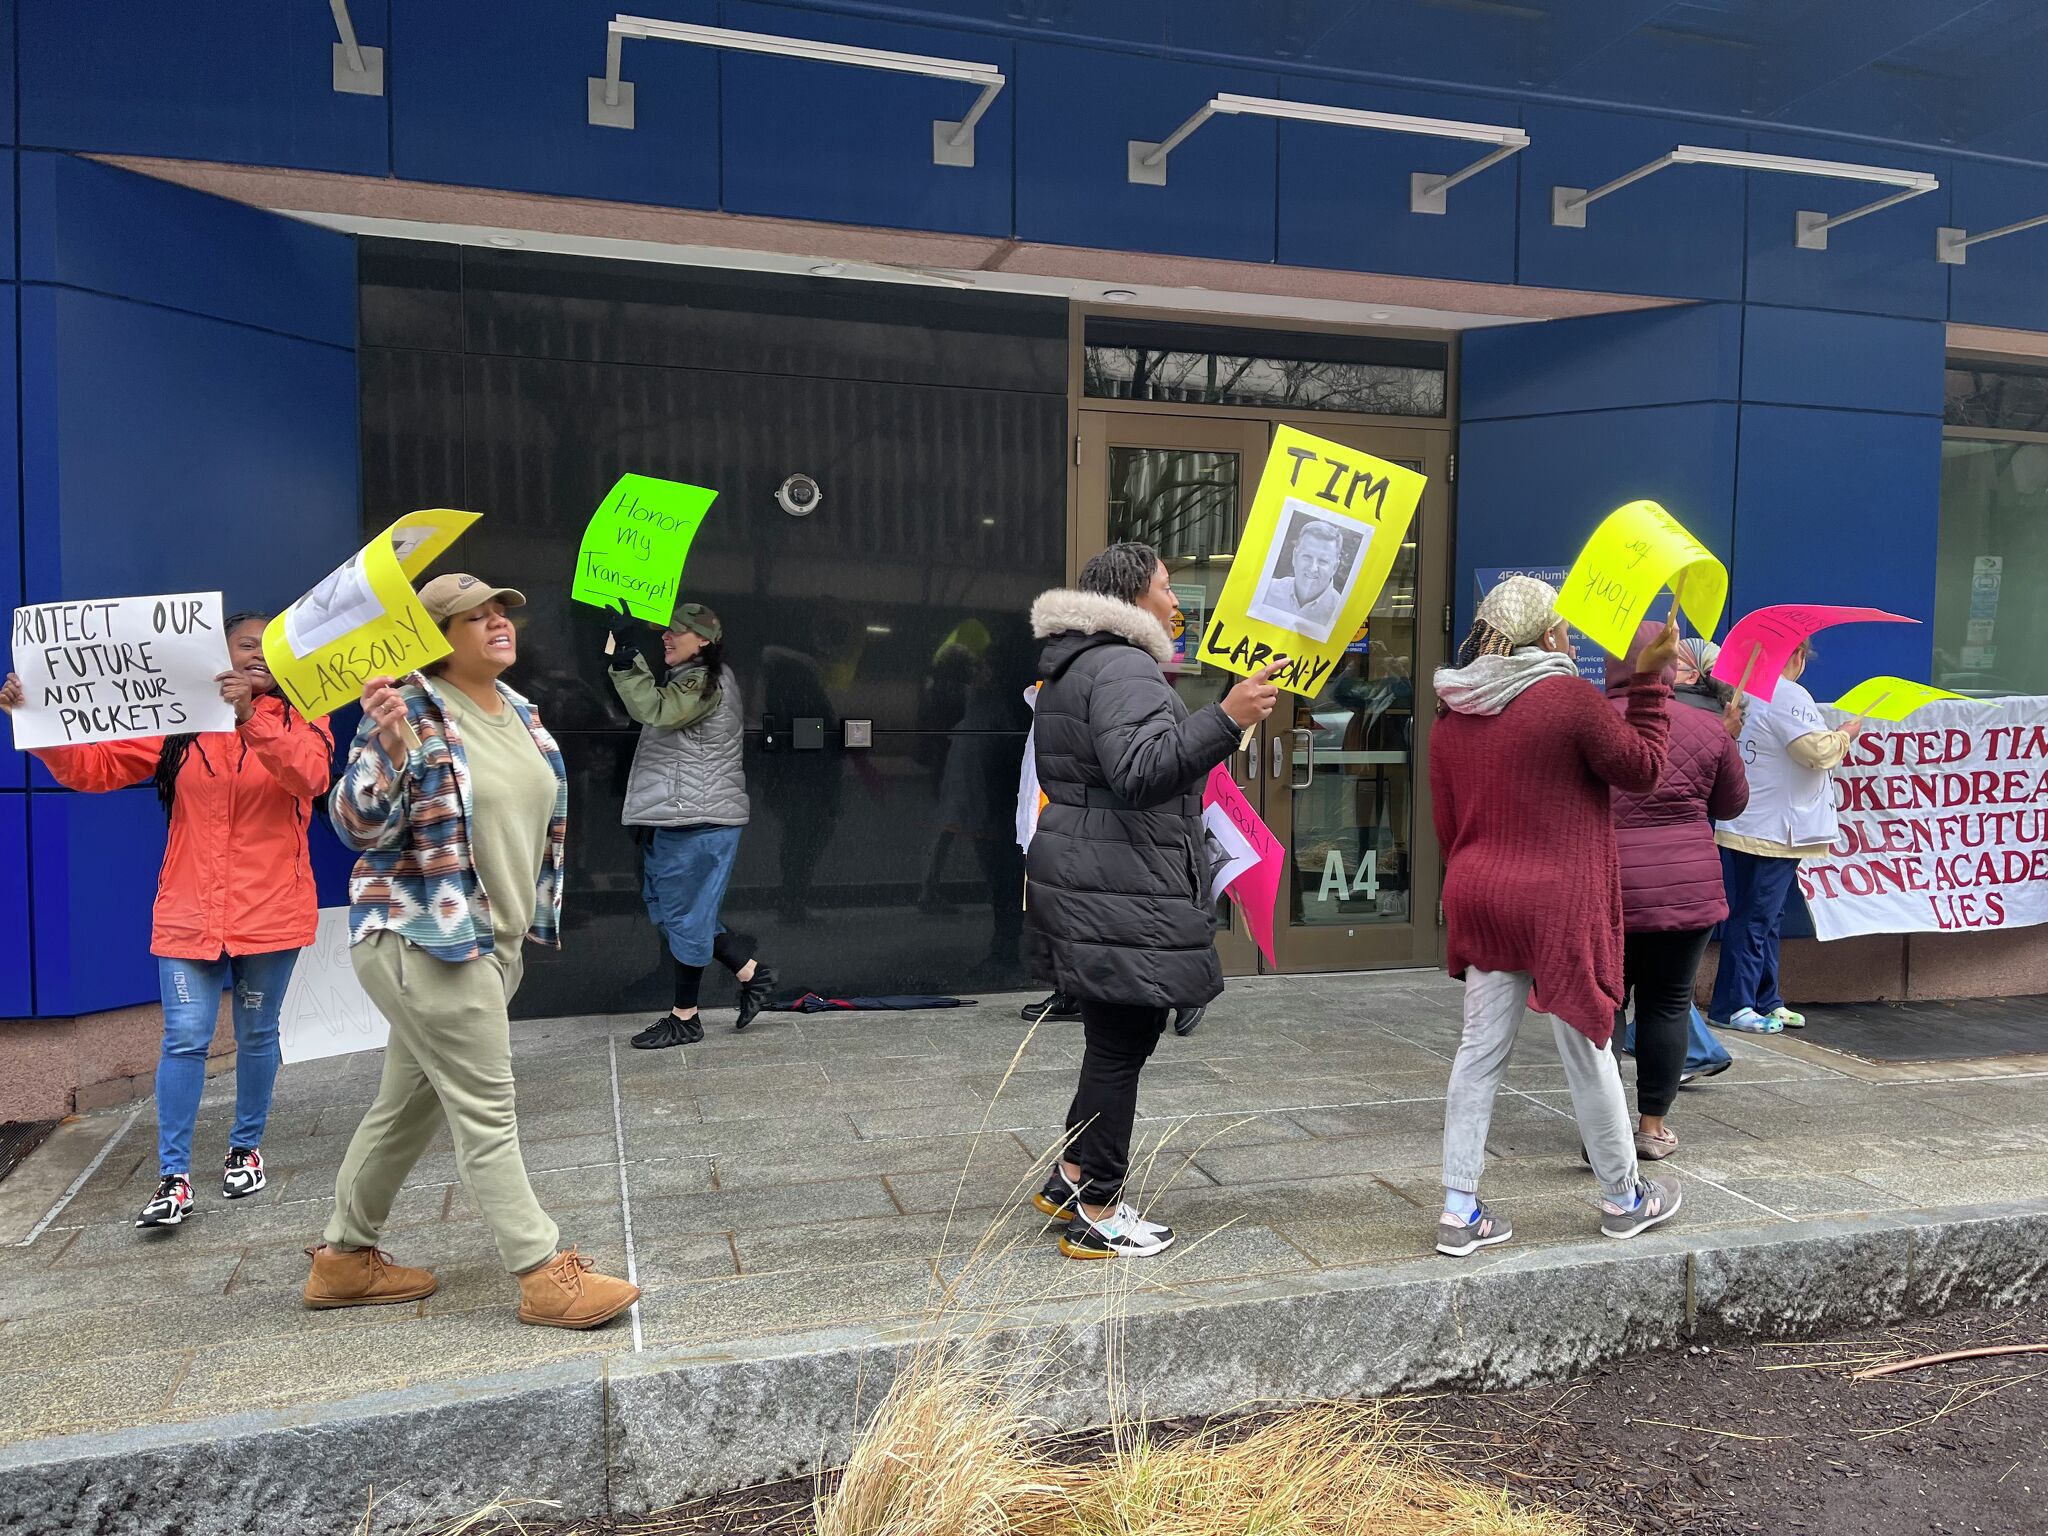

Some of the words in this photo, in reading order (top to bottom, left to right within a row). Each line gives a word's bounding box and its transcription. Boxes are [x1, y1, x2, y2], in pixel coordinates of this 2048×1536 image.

[1287, 446, 1390, 522] TIM
[614, 492, 692, 532] Honor
[583, 550, 675, 601] Transcript!
[1527, 569, 1569, 580] Columb
[1584, 562, 1636, 632] Honk
[15, 602, 120, 647] PROTECT
[153, 600, 212, 634] OUR
[44, 641, 162, 680] FUTURE
[284, 605, 430, 710] LARSON-Y
[44, 681, 96, 707] NOT
[112, 677, 176, 702] YOUR
[59, 702, 187, 740] POCKETS
[1791, 705, 1818, 722] 6/2
[1841, 728, 1972, 768] STED
[1981, 726, 2048, 761] TIM
[1828, 817, 1935, 858] OLEN
[1936, 809, 2048, 851] FUTU
[1317, 850, 1379, 901] A4
[1935, 850, 2048, 891] ACADE
[1929, 892, 2005, 930] LIES
